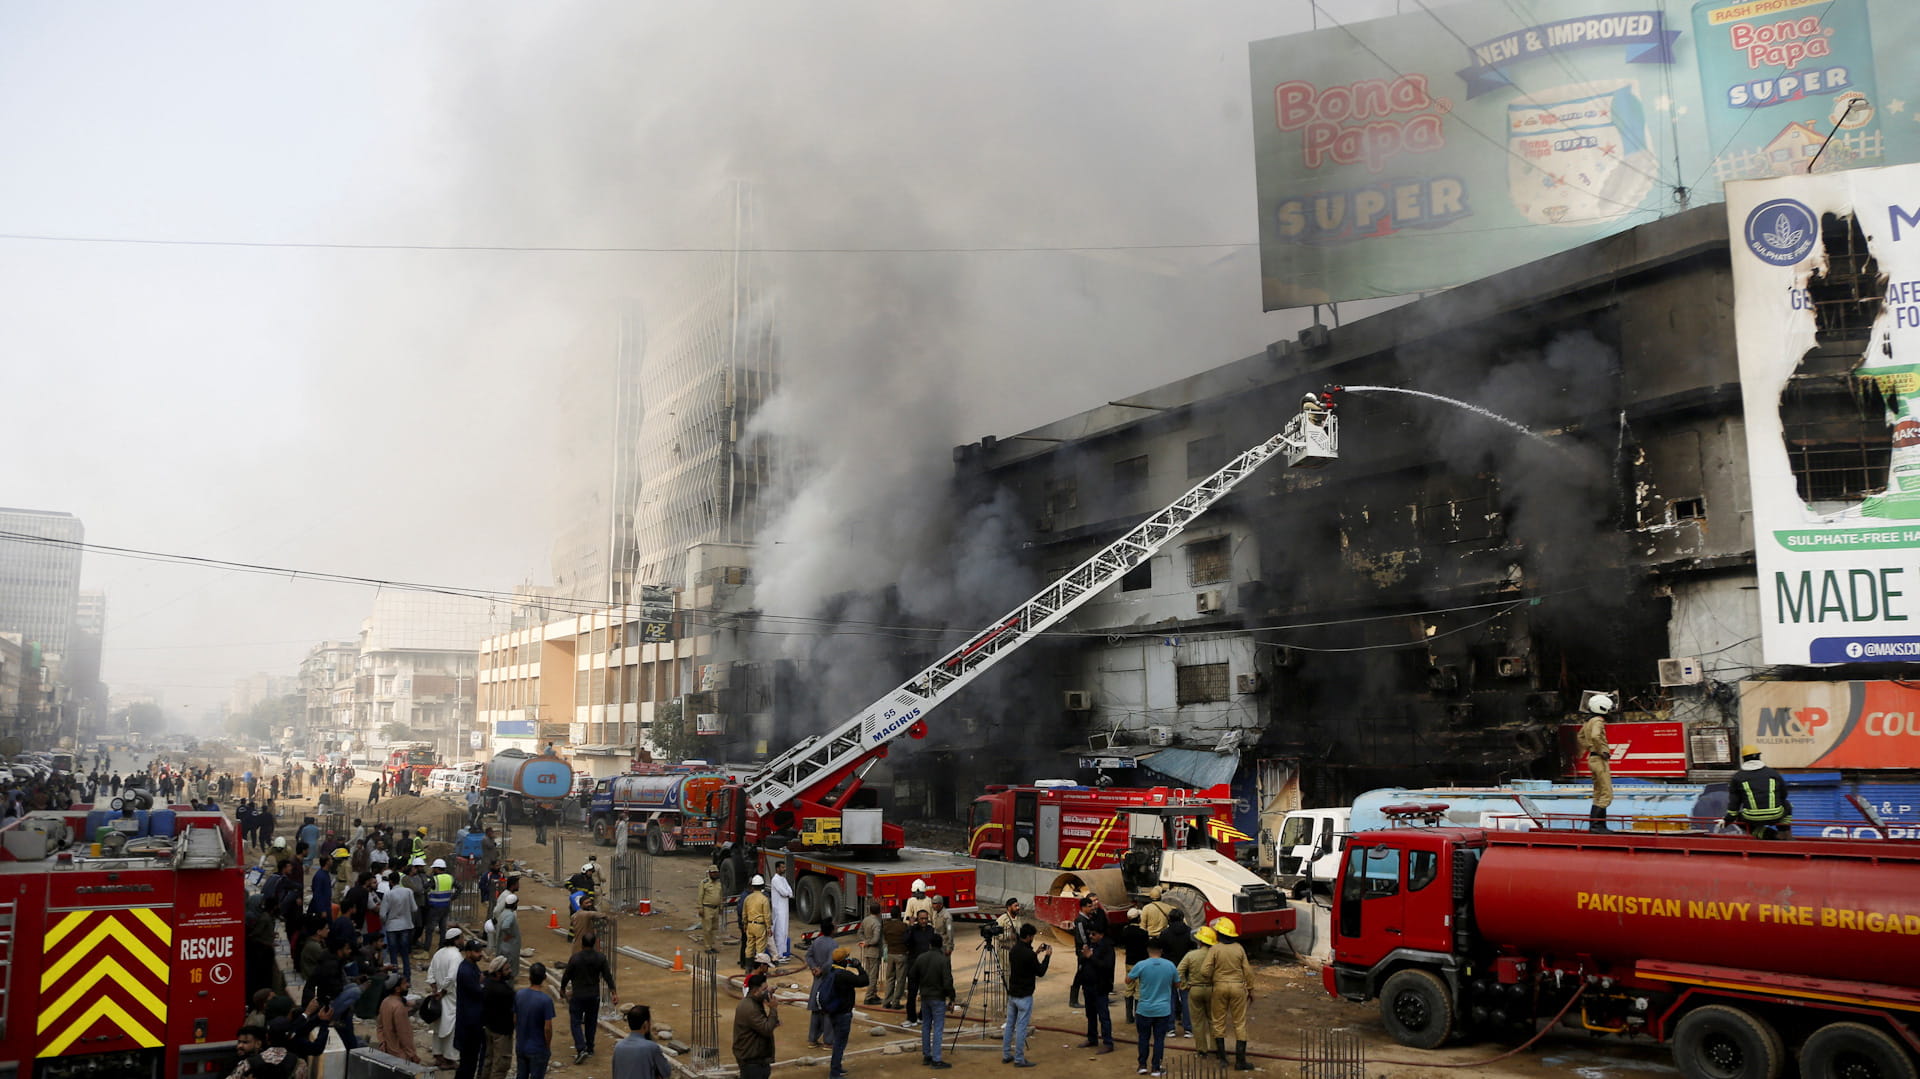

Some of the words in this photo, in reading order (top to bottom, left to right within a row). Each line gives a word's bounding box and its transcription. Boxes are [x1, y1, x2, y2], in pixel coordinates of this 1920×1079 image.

[1715, 7, 1751, 20] RASH
[1477, 37, 1519, 67] NEW
[1526, 31, 1544, 51] &
[1547, 15, 1654, 47] IMPROVED
[1731, 16, 1821, 50] Bona
[1747, 38, 1831, 70] Papa
[1730, 67, 1848, 106] SUPER
[1275, 74, 1431, 132] Bona
[1303, 114, 1445, 174] Papa
[1554, 136, 1598, 151] SUPER
[1278, 179, 1463, 236] SUPER
[1752, 241, 1794, 260] SULPHATE
[1793, 239, 1812, 257] FREE
[1884, 280, 1920, 306] AFE
[1788, 532, 1899, 546] SULPHATE-FREE
[1775, 567, 1908, 624] MADE
[645, 623, 667, 638] A2Z
[872, 707, 921, 742] MAGIRUS
[883, 708, 896, 720] 55
[1757, 707, 1829, 737] M&P
[199, 892, 223, 908] KMC
[1577, 891, 1681, 917] PAKISTAN
[1688, 900, 1751, 921] NAVY
[1759, 903, 1814, 926] FIRE
[1820, 907, 1920, 935] BRIGAD
[180, 936, 234, 960] RESCUE
[189, 968, 202, 984] 16
